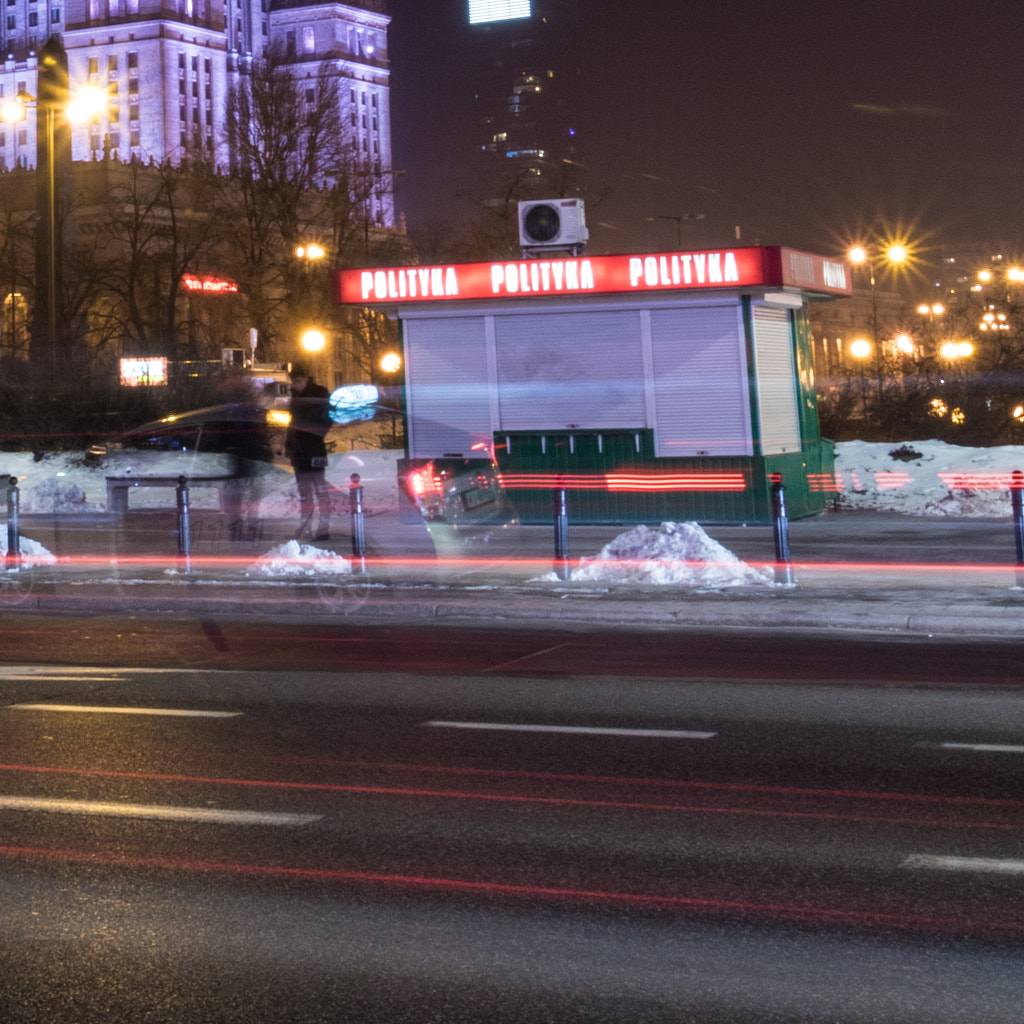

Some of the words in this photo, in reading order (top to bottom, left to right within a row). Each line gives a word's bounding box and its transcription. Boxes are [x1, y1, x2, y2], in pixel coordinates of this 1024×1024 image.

[360, 268, 458, 300] POLITYKA
[491, 261, 594, 293] POLITYKA
[629, 253, 738, 287] POLITYKA
